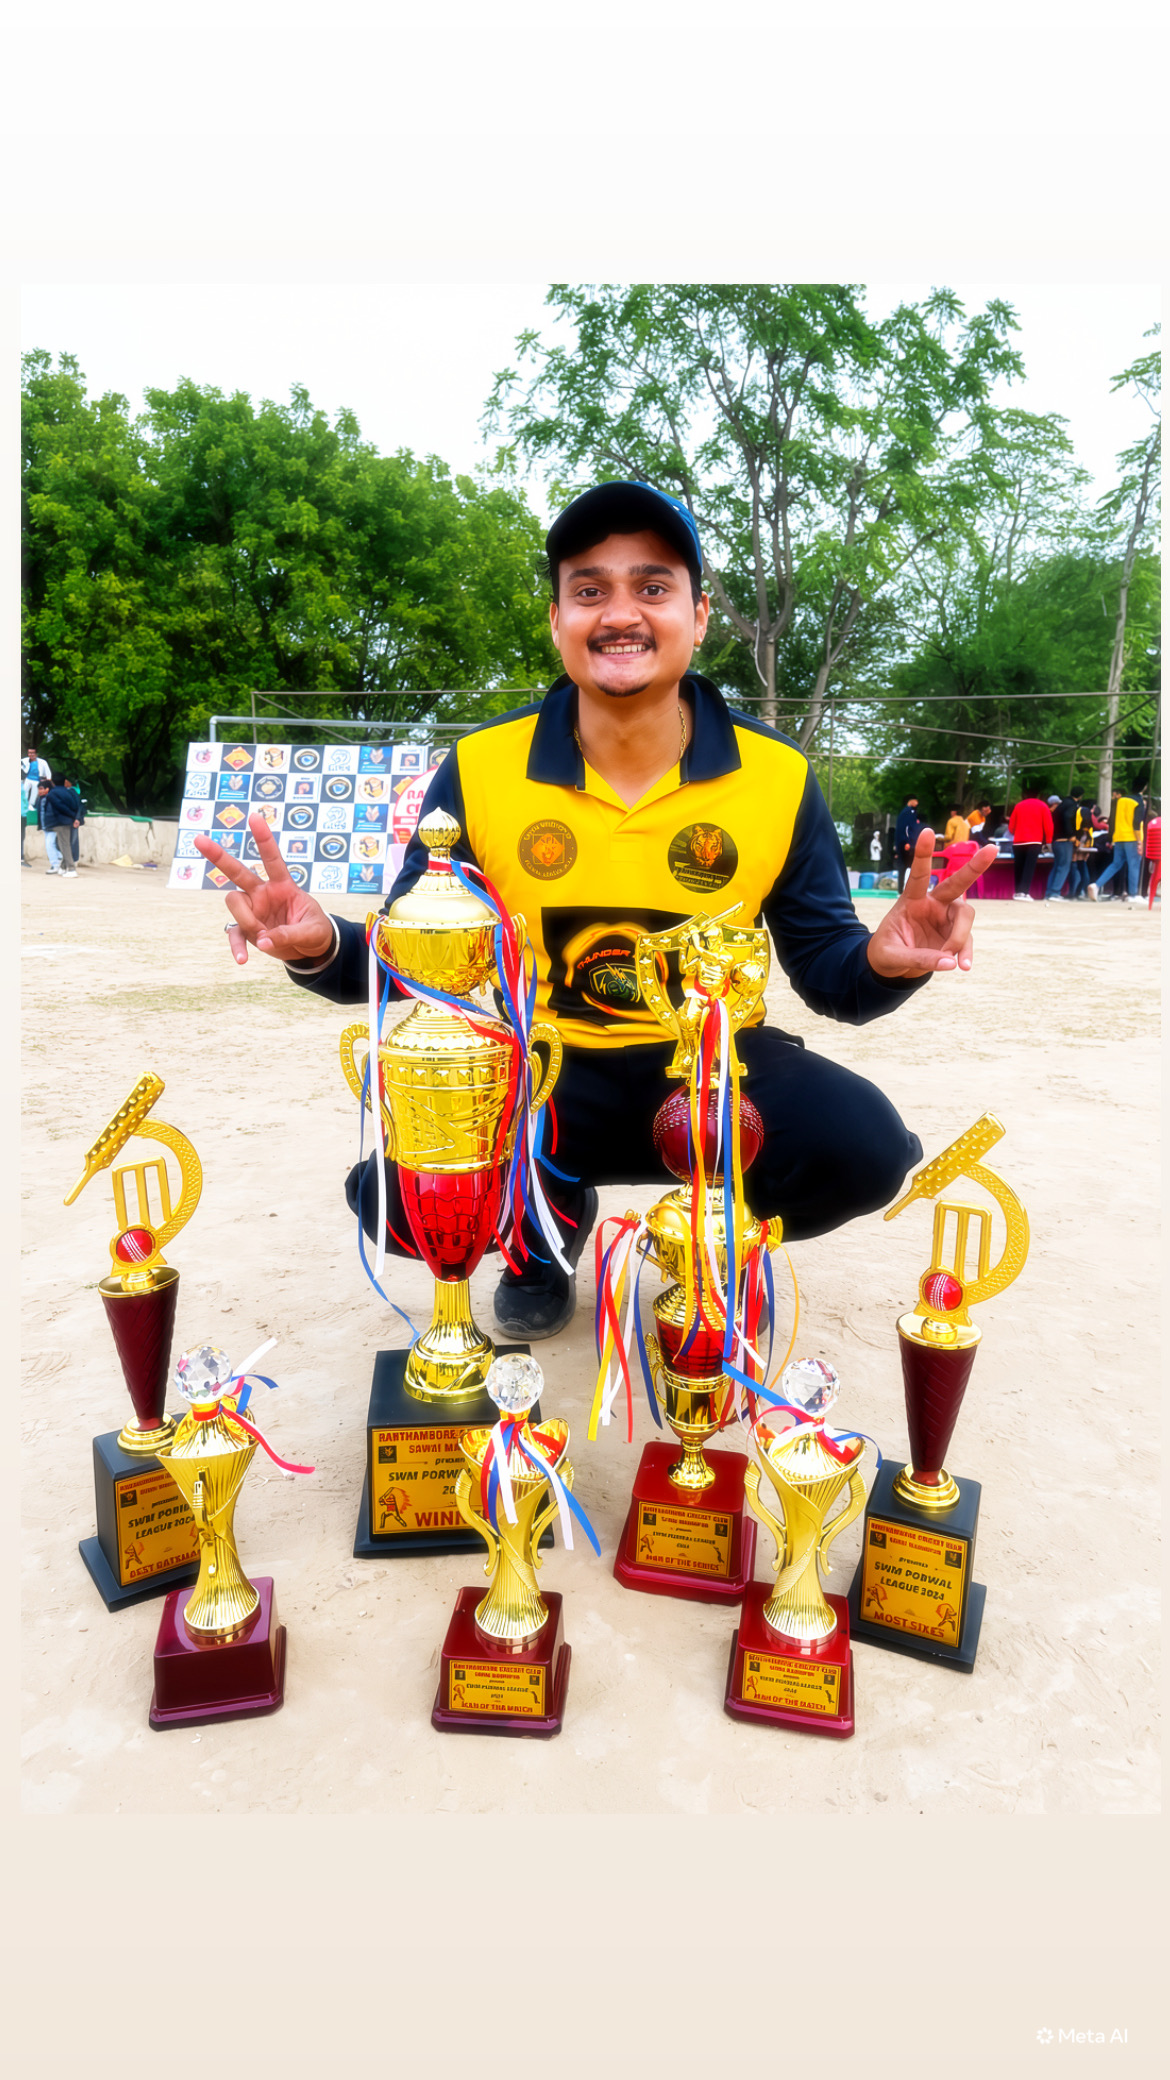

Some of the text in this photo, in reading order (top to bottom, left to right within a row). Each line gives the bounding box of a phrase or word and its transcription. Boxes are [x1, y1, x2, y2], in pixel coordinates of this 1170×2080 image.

[577, 949, 631, 969] THUNDER
[880, 1576, 919, 1594] LEAGUE
[873, 1610, 945, 1638] MOST SIXES
